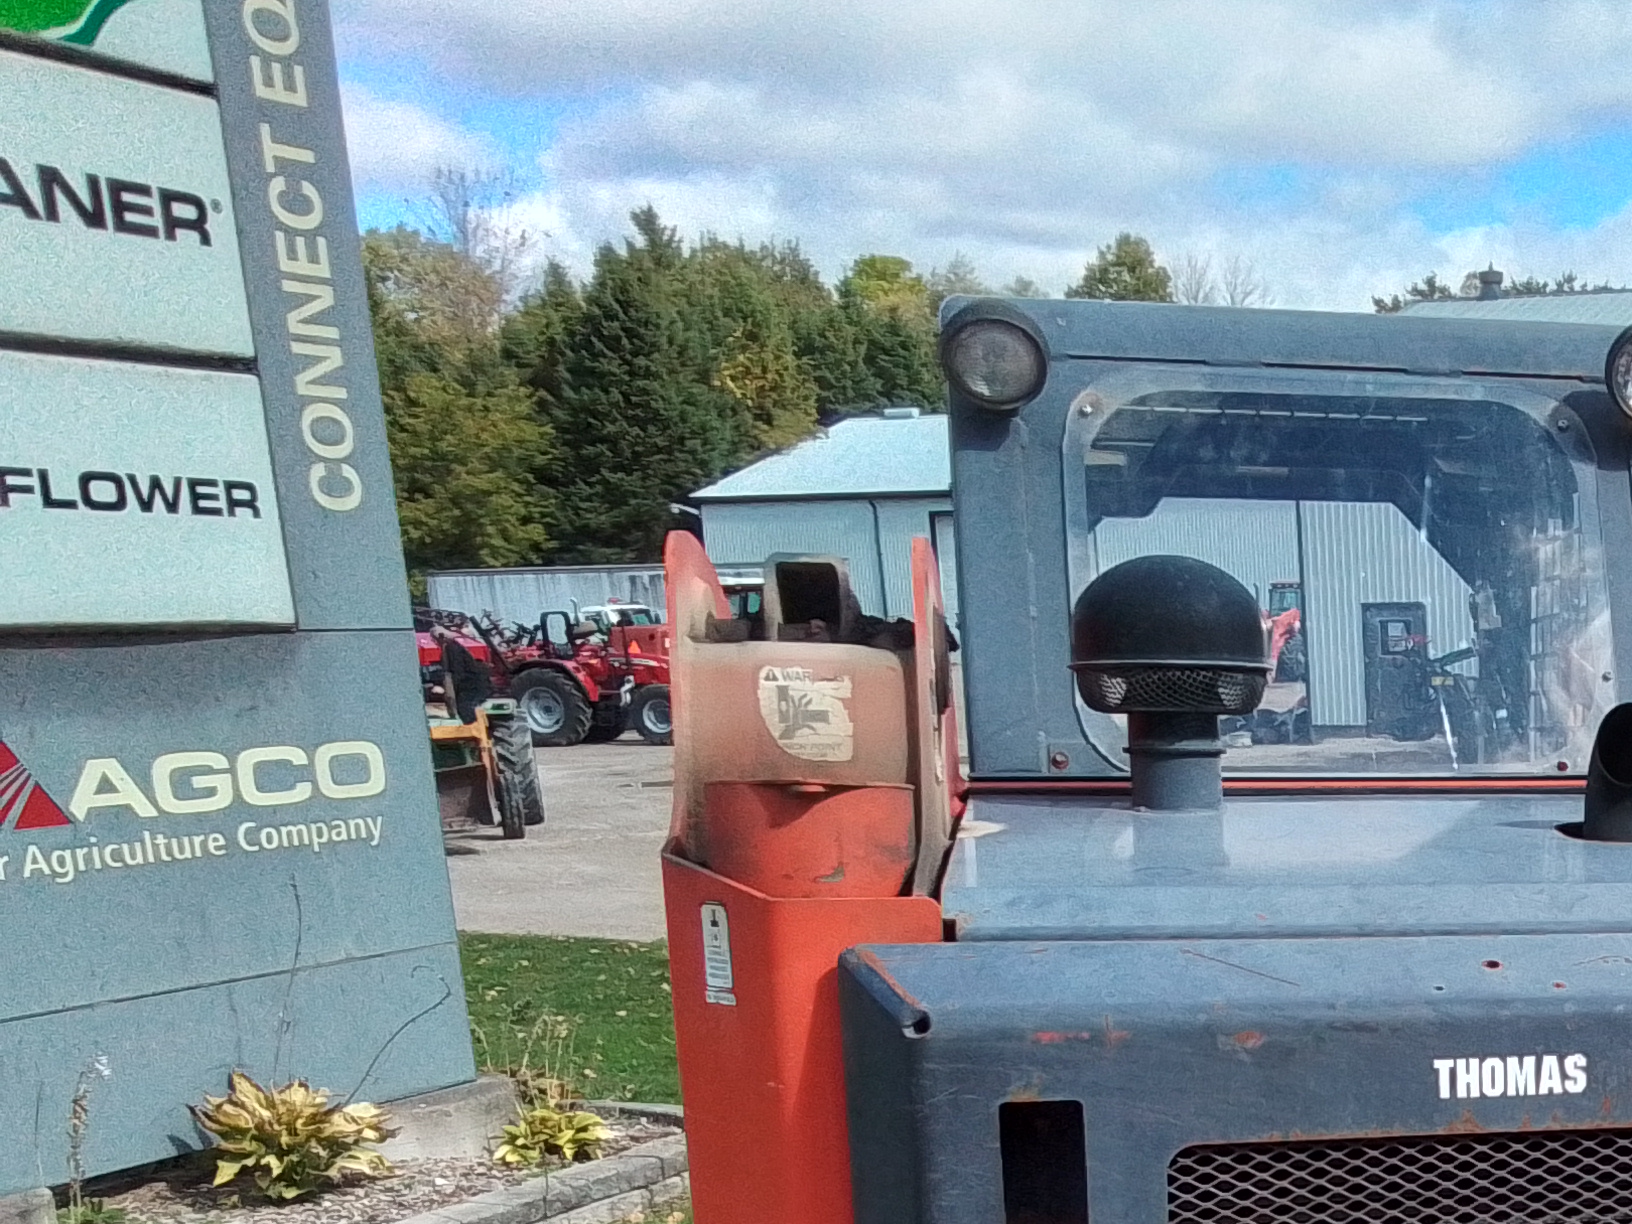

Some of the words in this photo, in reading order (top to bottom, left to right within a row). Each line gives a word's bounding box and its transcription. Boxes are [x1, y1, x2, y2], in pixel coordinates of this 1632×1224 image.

[259, 122, 363, 512] CONNECT
[0, 465, 262, 520] FLOWER
[68, 741, 387, 822] AGCO
[23, 830, 227, 883] Agriculture
[237, 816, 384, 853] Company
[1432, 1053, 1588, 1100] THOMAS
